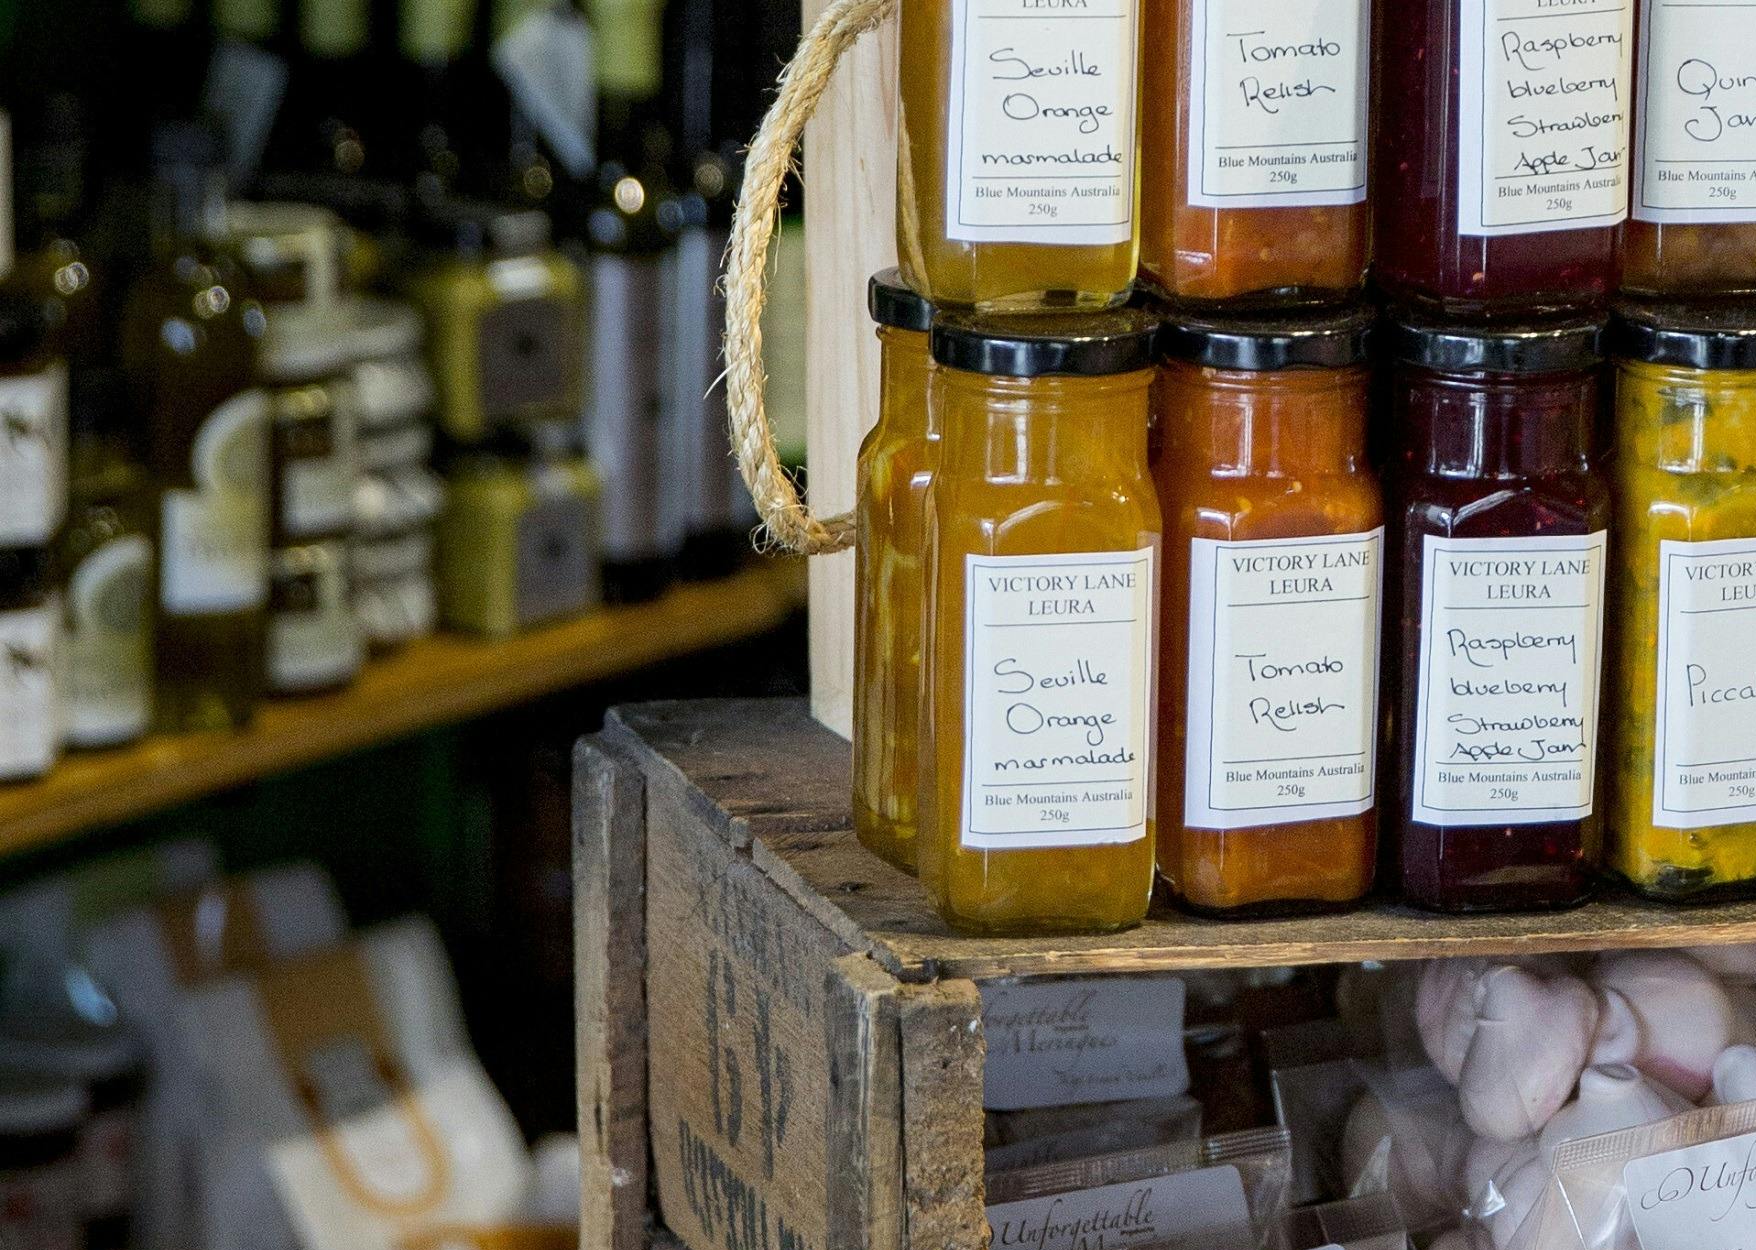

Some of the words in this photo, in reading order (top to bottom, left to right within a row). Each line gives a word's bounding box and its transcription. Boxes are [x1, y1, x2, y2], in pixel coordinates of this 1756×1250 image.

[1226, 31, 1341, 63] Tomato
[1502, 31, 1622, 71] Raspberry
[990, 48, 1102, 80] Seville
[1240, 76, 1336, 114] Relish
[1003, 93, 1112, 133] Orange
[982, 145, 1122, 165] marmalade
[1219, 156, 1244, 168] Blue
[1249, 153, 1306, 166] Mountains
[1310, 151, 1358, 164] Australia
[1514, 151, 1570, 175] Apple
[1270, 171, 1298, 184] 250g
[1658, 169, 1684, 182] Blue
[1688, 169, 1746, 181] Mountains
[975, 186, 1002, 198] Blue
[1007, 186, 1067, 198] Mountains
[1071, 185, 1120, 197] Australia
[1709, 187, 1737, 200] 250g
[1029, 204, 1058, 217] 250g
[1546, 198, 1572, 211] 250g
[1232, 554, 1319, 573] VICTORY
[1323, 550, 1370, 568] LANE
[1449, 560, 1537, 577] VICTORY
[1541, 559, 1591, 575] LANE
[989, 575, 1078, 593] VICTORY
[1084, 573, 1136, 589] LANE
[1270, 577, 1334, 595] LEURA
[1487, 584, 1551, 600] LEURA
[1028, 599, 1095, 616] LEURA
[1446, 628, 1577, 667] Raspberry
[994, 658, 1108, 694] Seville
[1235, 653, 1343, 682] Tomato
[1249, 697, 1345, 731] Relish
[1007, 702, 1117, 746] Orange
[1447, 713, 1585, 744] Strawberry
[994, 747, 1136, 771] marmalade
[1450, 741, 1513, 762] Apple
[1518, 739, 1587, 761] Jam
[1226, 770, 1252, 783] Blue
[1256, 767, 1314, 781] Mountains
[1317, 763, 1365, 777] Australia
[1438, 771, 1465, 783] Blue
[1468, 771, 1528, 783] Mountains
[1531, 770, 1582, 782] Australia
[1679, 773, 1704, 786] Blue
[985, 794, 1013, 806] Blue
[1016, 792, 1078, 804] Mountains
[1081, 789, 1133, 802] Australia
[1277, 784, 1306, 797] 250g
[1490, 788, 1519, 801] 250g
[1728, 785, 1755, 798] 250g
[1040, 809, 1070, 823] 250g
